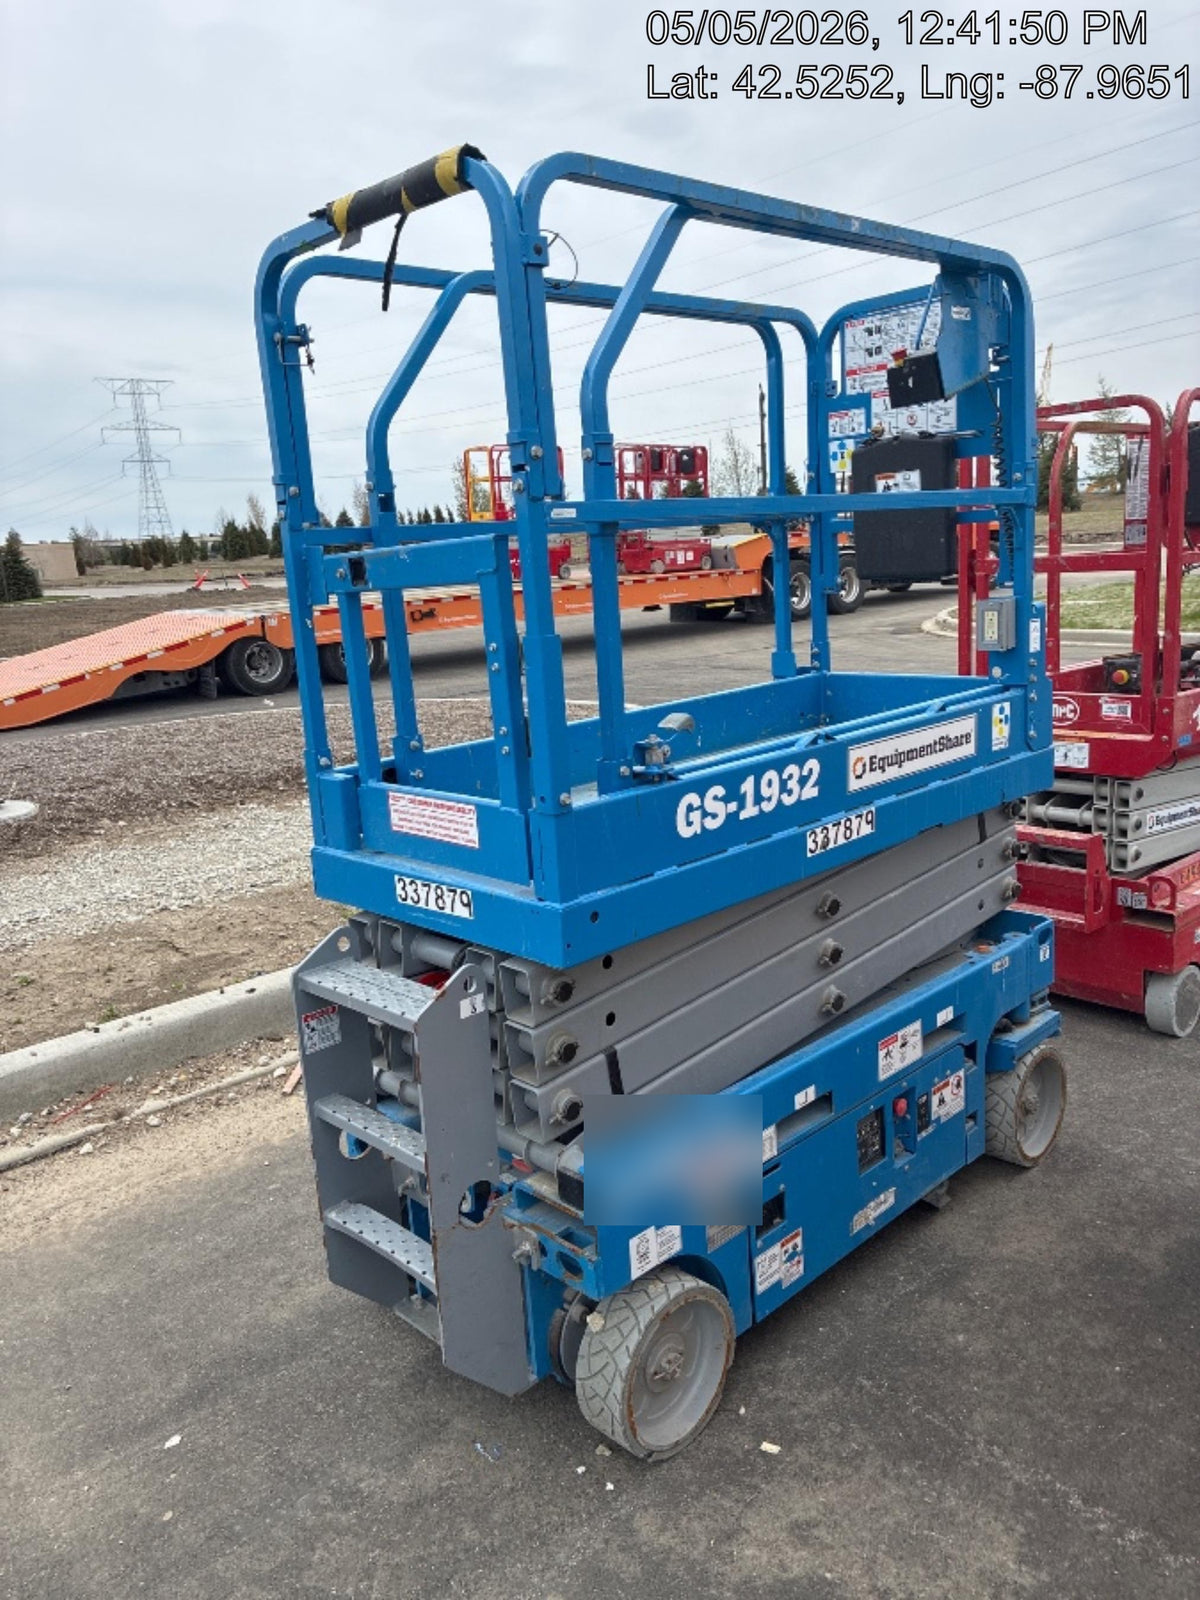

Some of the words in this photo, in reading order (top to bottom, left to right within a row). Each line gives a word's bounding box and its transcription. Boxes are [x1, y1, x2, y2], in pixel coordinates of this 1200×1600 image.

[868, 731, 972, 773] EquipmentShare
[676, 758, 821, 838] GS-1932
[397, 877, 473, 918] 337879
